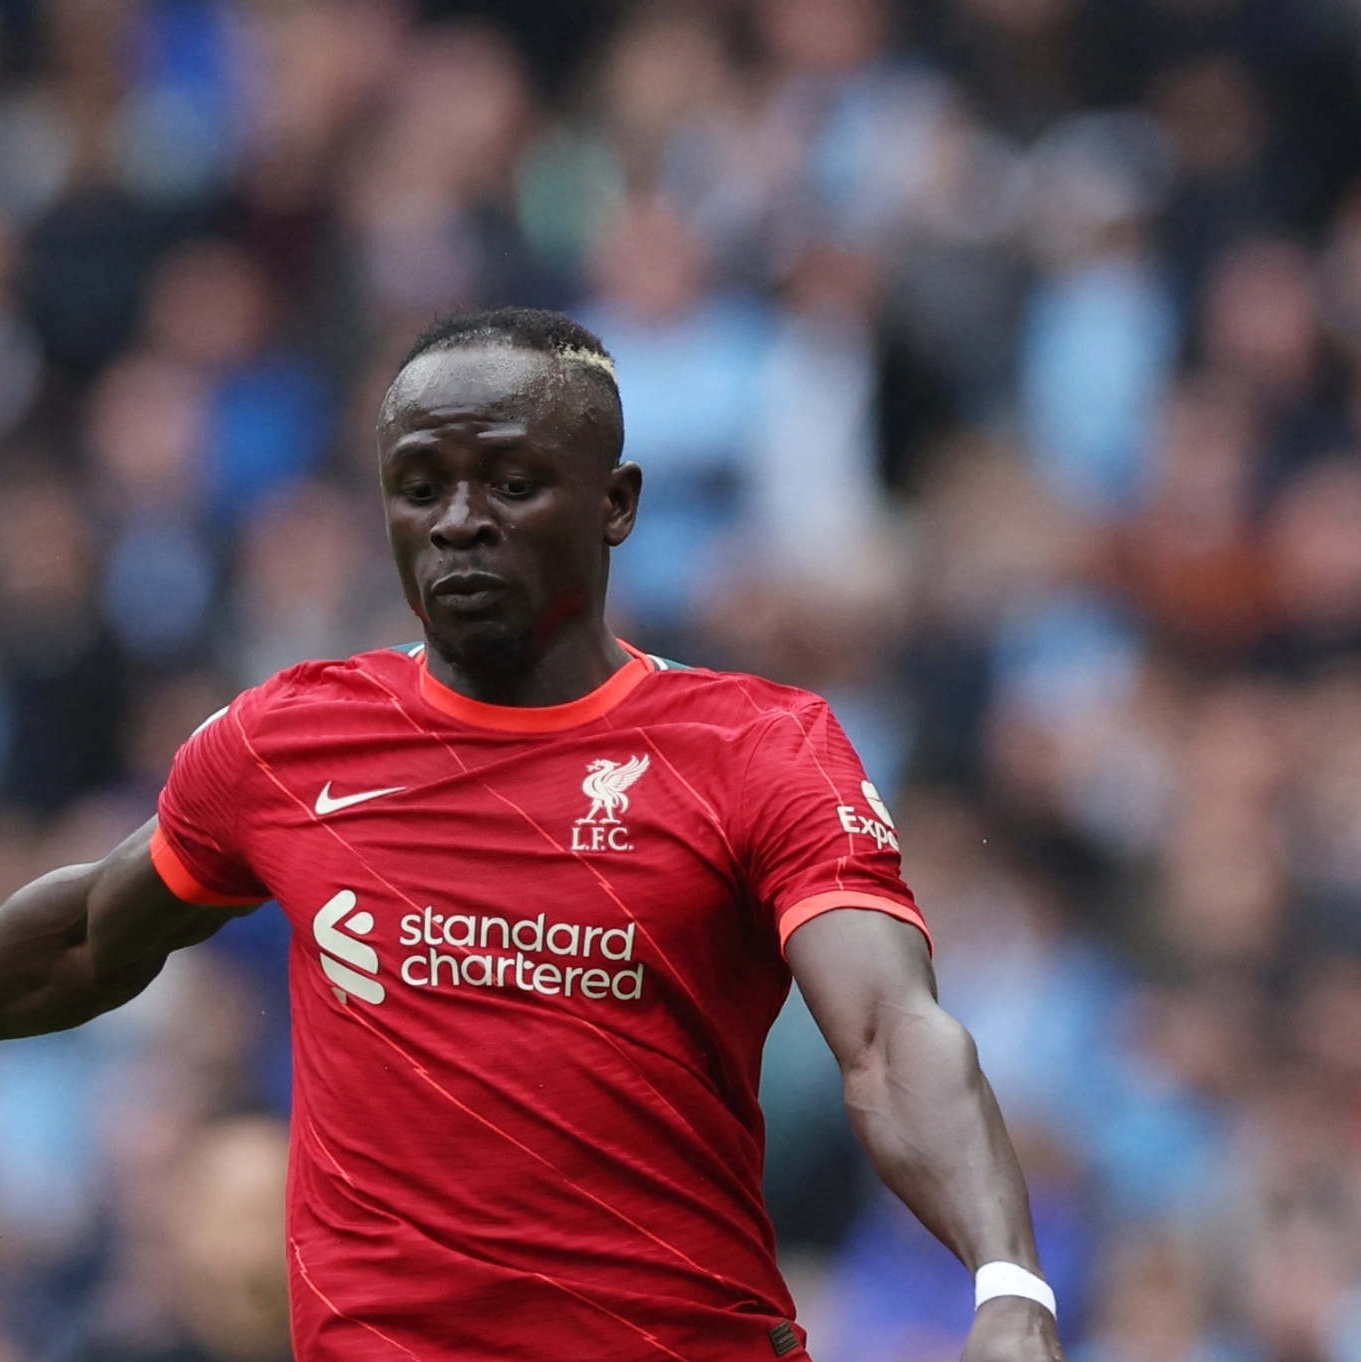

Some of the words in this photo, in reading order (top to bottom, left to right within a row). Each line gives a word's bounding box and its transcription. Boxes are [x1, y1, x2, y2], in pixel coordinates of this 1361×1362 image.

[571, 826, 634, 851] L.F.C.
[399, 905, 636, 962] standard
[400, 947, 644, 1001] chartered
